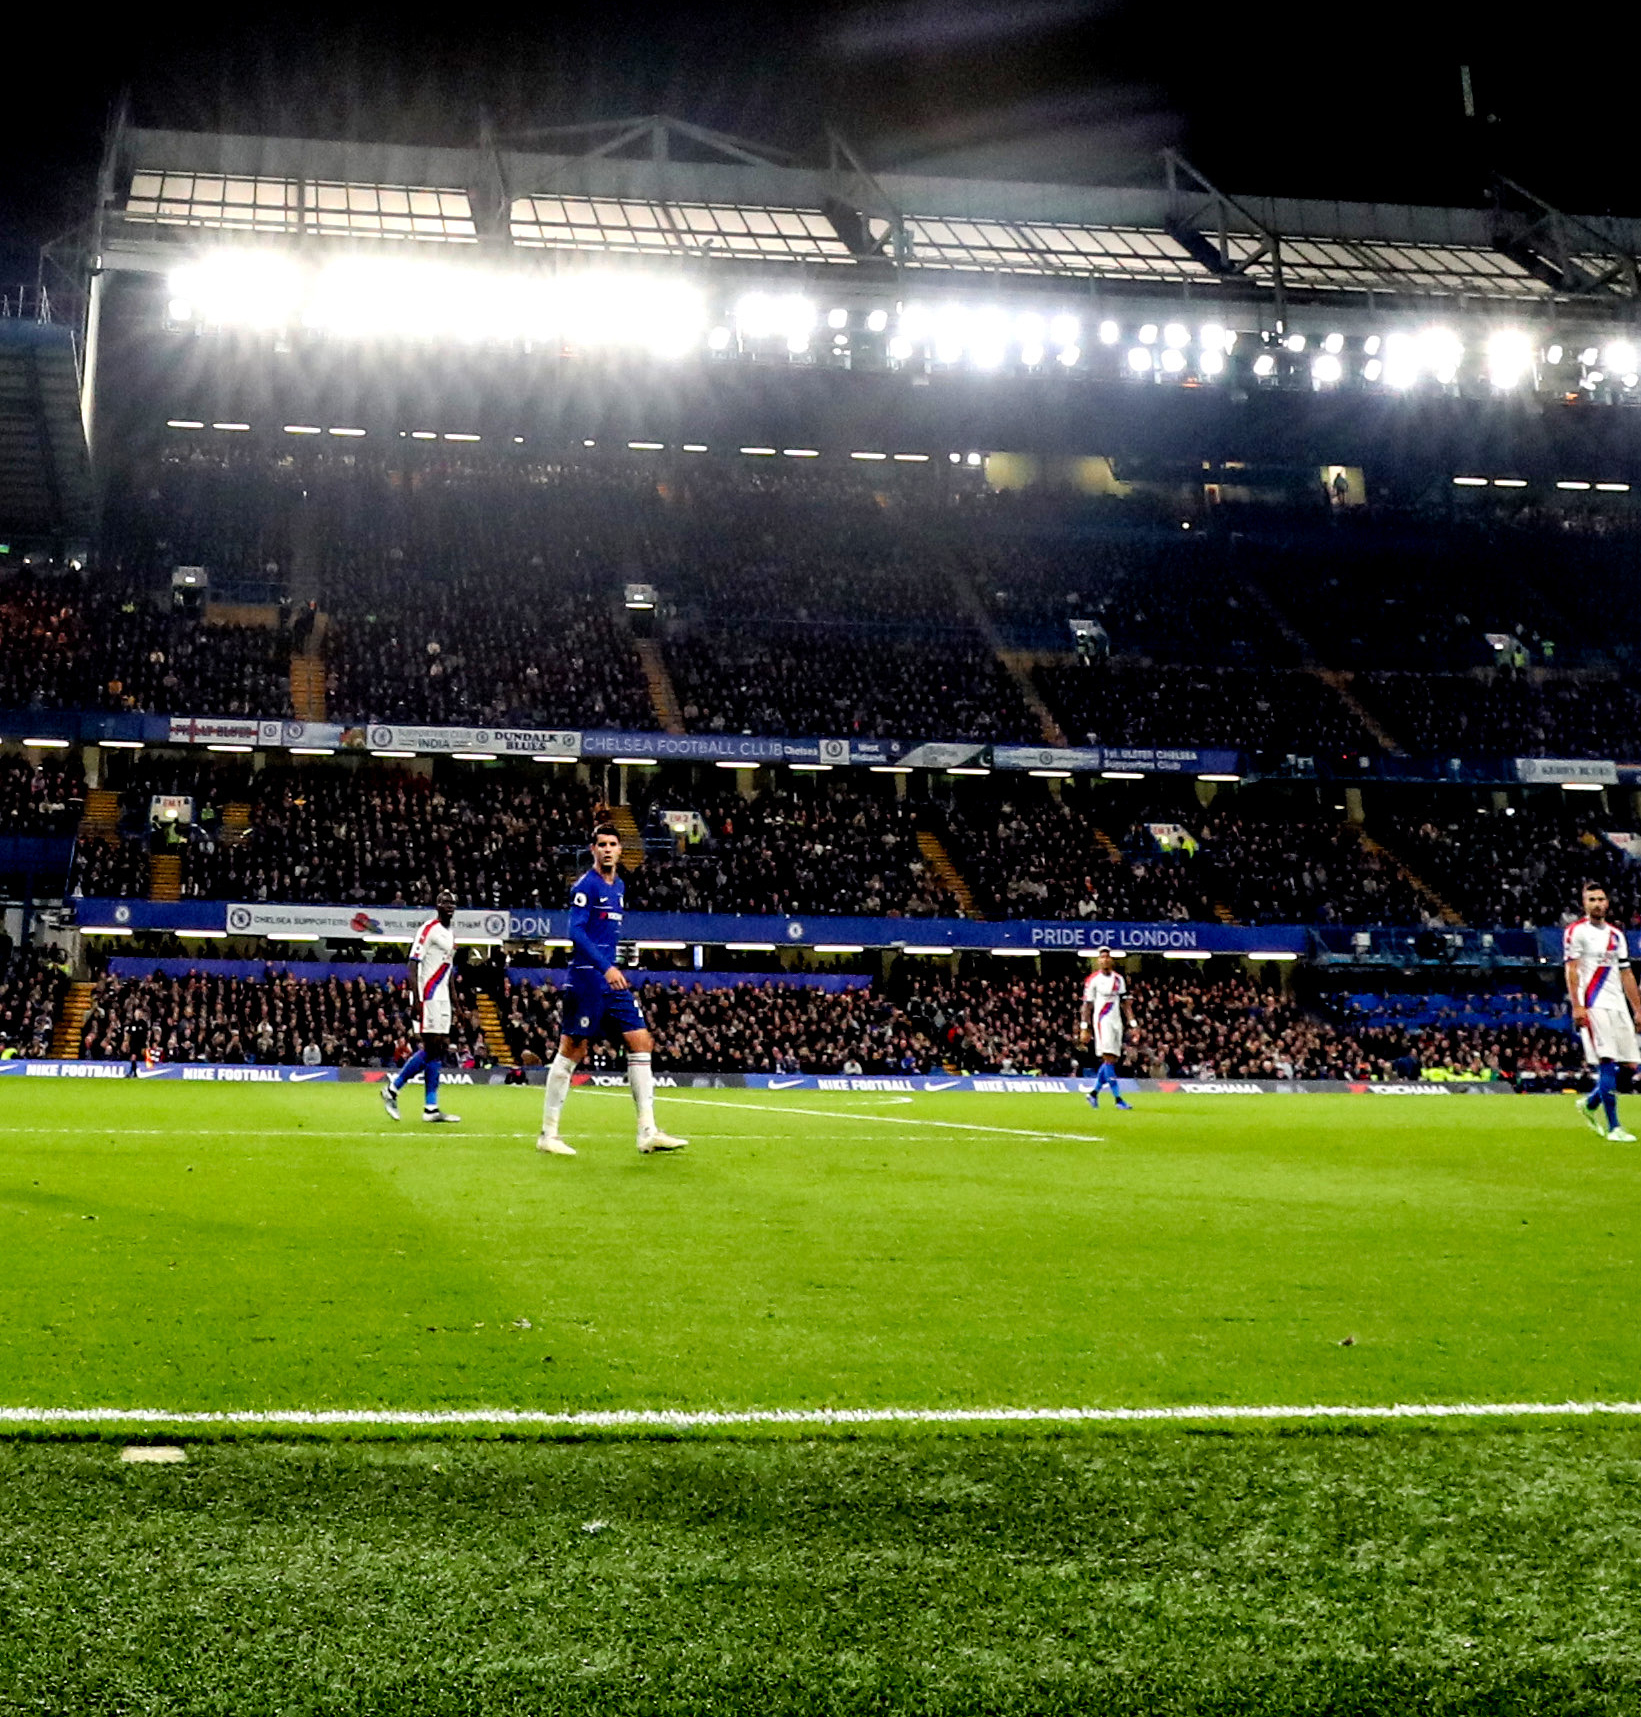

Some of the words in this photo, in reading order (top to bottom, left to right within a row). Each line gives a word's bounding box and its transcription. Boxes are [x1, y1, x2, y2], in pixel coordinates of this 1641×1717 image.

[418, 738, 450, 749] INDIA
[494, 731, 558, 743] DUNDALK
[506, 741, 546, 751] BLUES
[583, 737, 653, 752] CHELSEA
[657, 738, 735, 755] FOOTBALL
[253, 916, 292, 924] CHELSEA
[1032, 928, 1085, 945] PRIDE
[1089, 929, 1115, 946] OF
[1120, 930, 1197, 947] LONDON
[26, 1064, 58, 1076] NIKE
[61, 1064, 127, 1078] FOOTBALL
[183, 1067, 214, 1080] NIKE
[217, 1067, 282, 1081] FOOTBALL
[817, 1078, 849, 1091] NIKE
[851, 1079, 915, 1092] FOOTBALL
[973, 1079, 1005, 1092] NIKE
[1006, 1080, 1070, 1093] FOOTBALL
[1180, 1083, 1263, 1094] YOKOHAMA
[1368, 1084, 1451, 1096] YOKOHAMA
